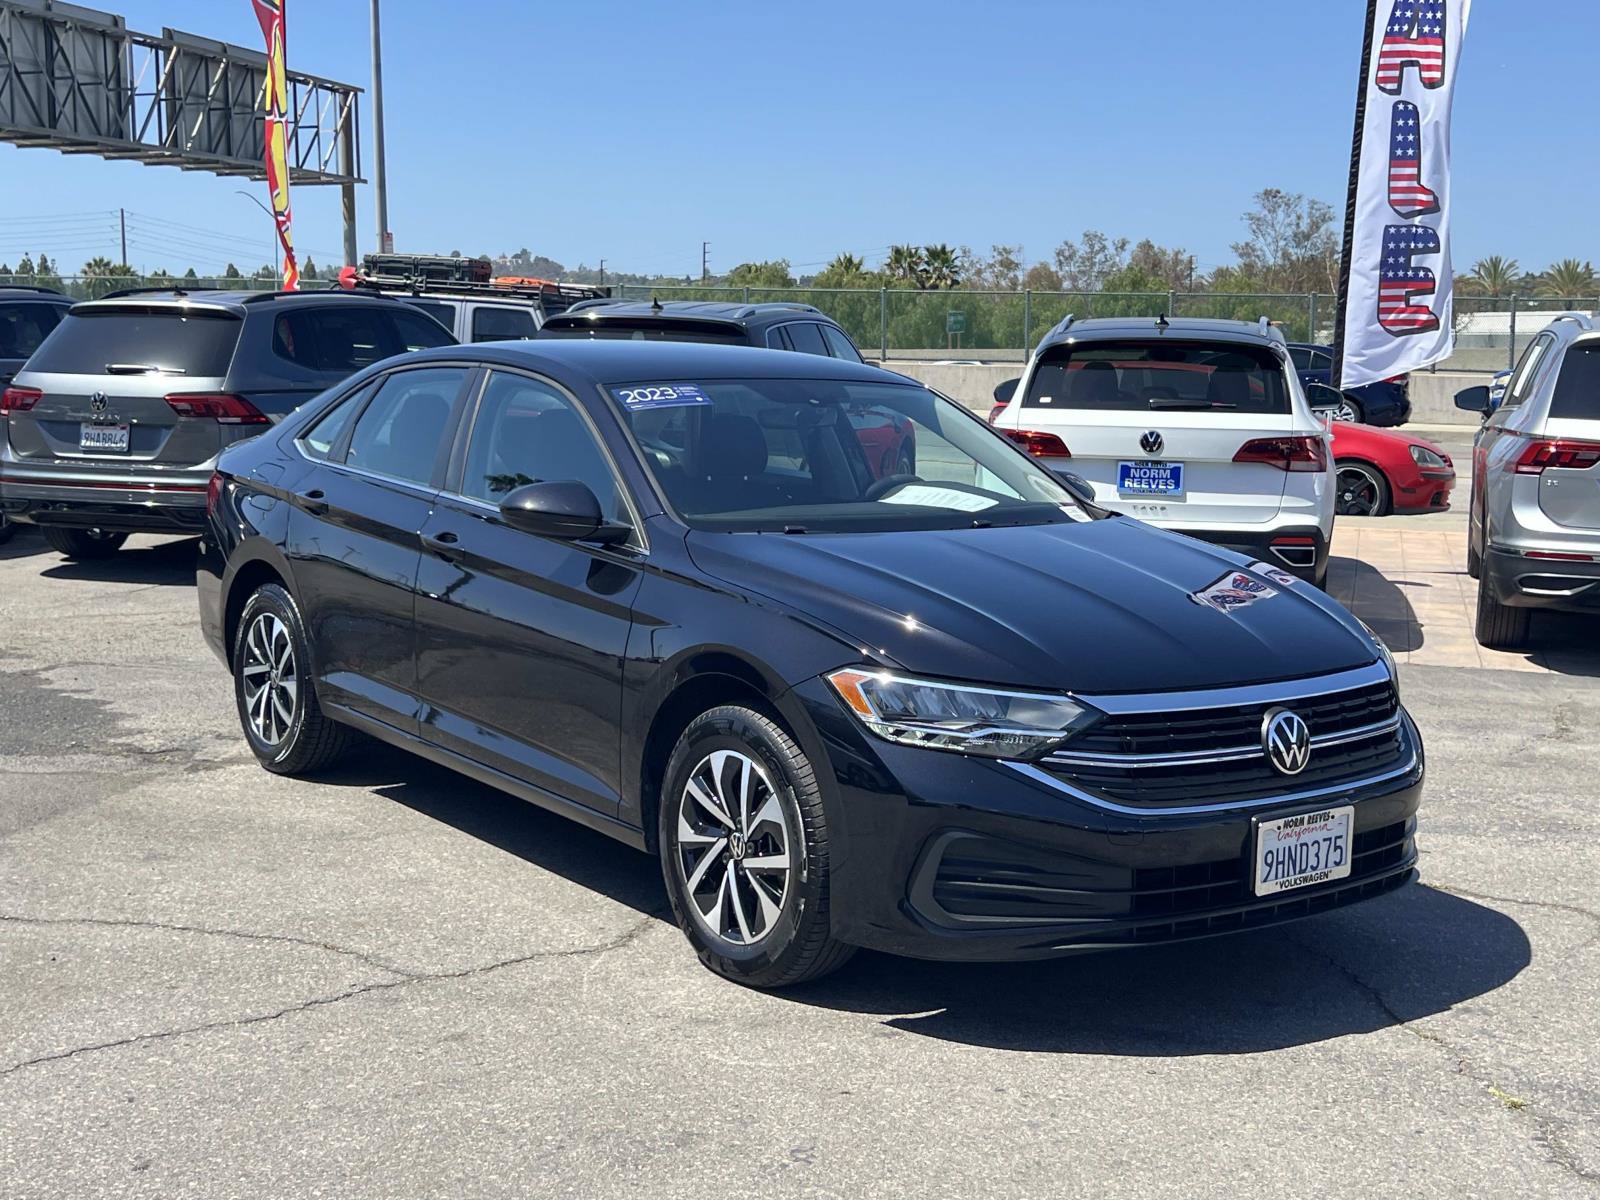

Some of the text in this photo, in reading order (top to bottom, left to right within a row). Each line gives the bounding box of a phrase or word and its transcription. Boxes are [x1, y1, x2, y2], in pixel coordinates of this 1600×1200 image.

[620, 386, 678, 403] 2023
[1130, 468, 1171, 479] NORM
[1124, 478, 1175, 489] REEVES
[1283, 811, 1331, 830] NORM REEVES
[1277, 823, 1333, 842] California
[1262, 835, 1343, 883] 9HND375
[1278, 871, 1329, 889] VOLKSWAGEN
